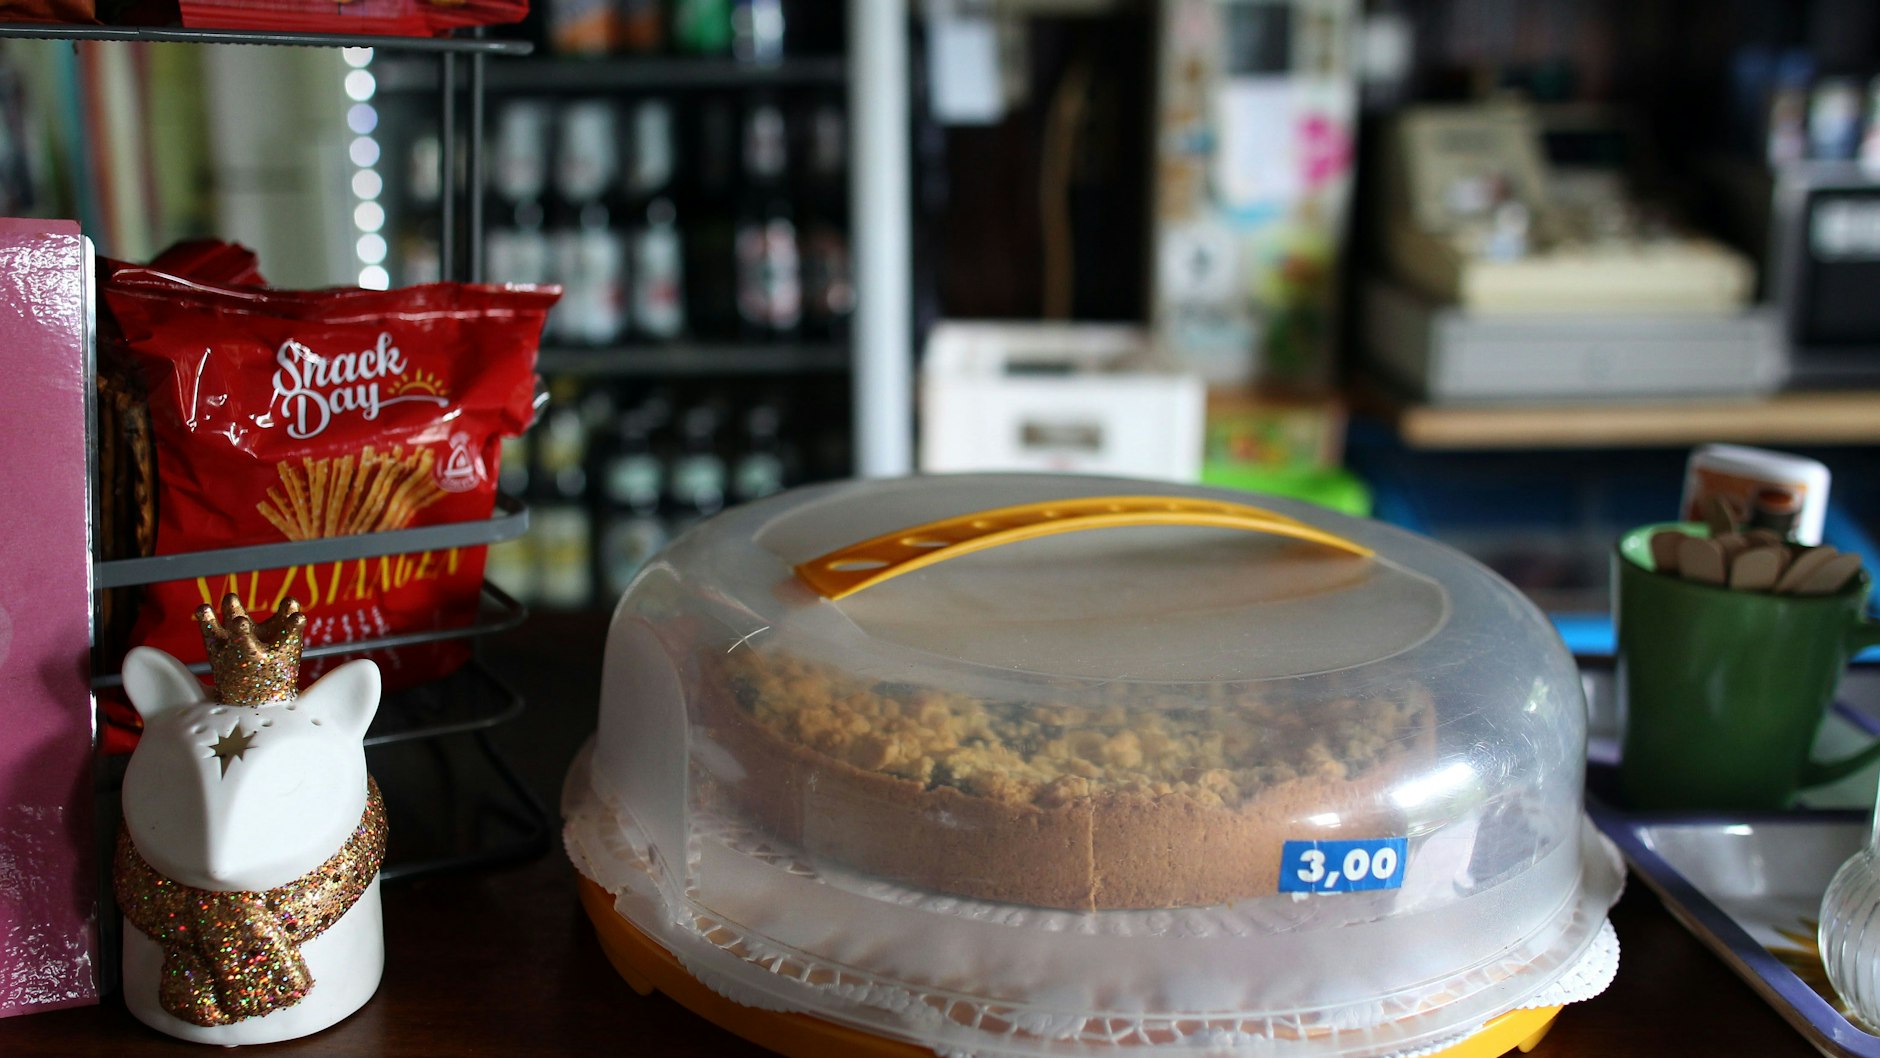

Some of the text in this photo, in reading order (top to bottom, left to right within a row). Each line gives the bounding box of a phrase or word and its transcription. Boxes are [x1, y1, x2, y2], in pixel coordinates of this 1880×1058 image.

[272, 332, 408, 397] Snack
[281, 382, 381, 439] Day
[1297, 847, 1398, 888] 3,00
